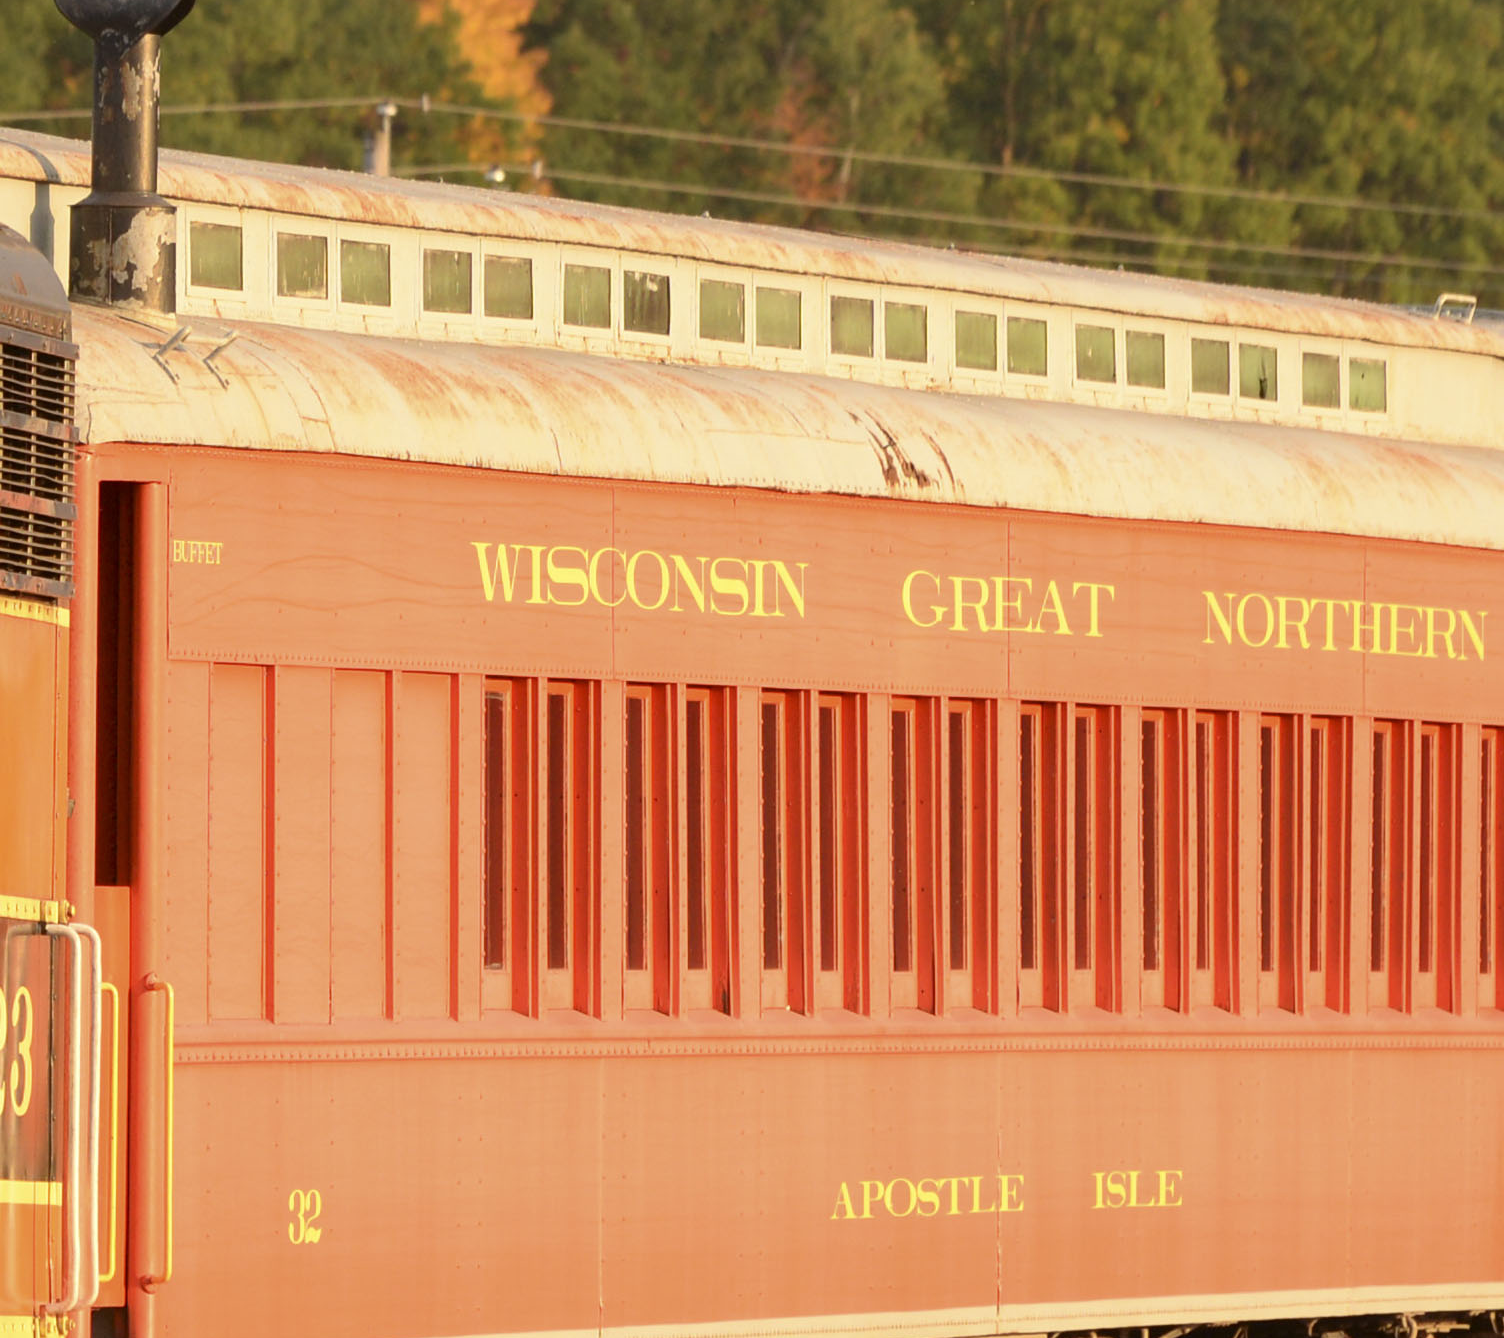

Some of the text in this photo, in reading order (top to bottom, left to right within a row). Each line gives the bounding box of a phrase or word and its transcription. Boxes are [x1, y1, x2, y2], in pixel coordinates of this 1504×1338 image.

[173, 539, 223, 565] BUFFET
[471, 541, 1489, 662] WISCONSIN GREAT NORTHERN
[287, 1188, 323, 1245] 32
[831, 1169, 1184, 1220] APOSTLE ISLE
